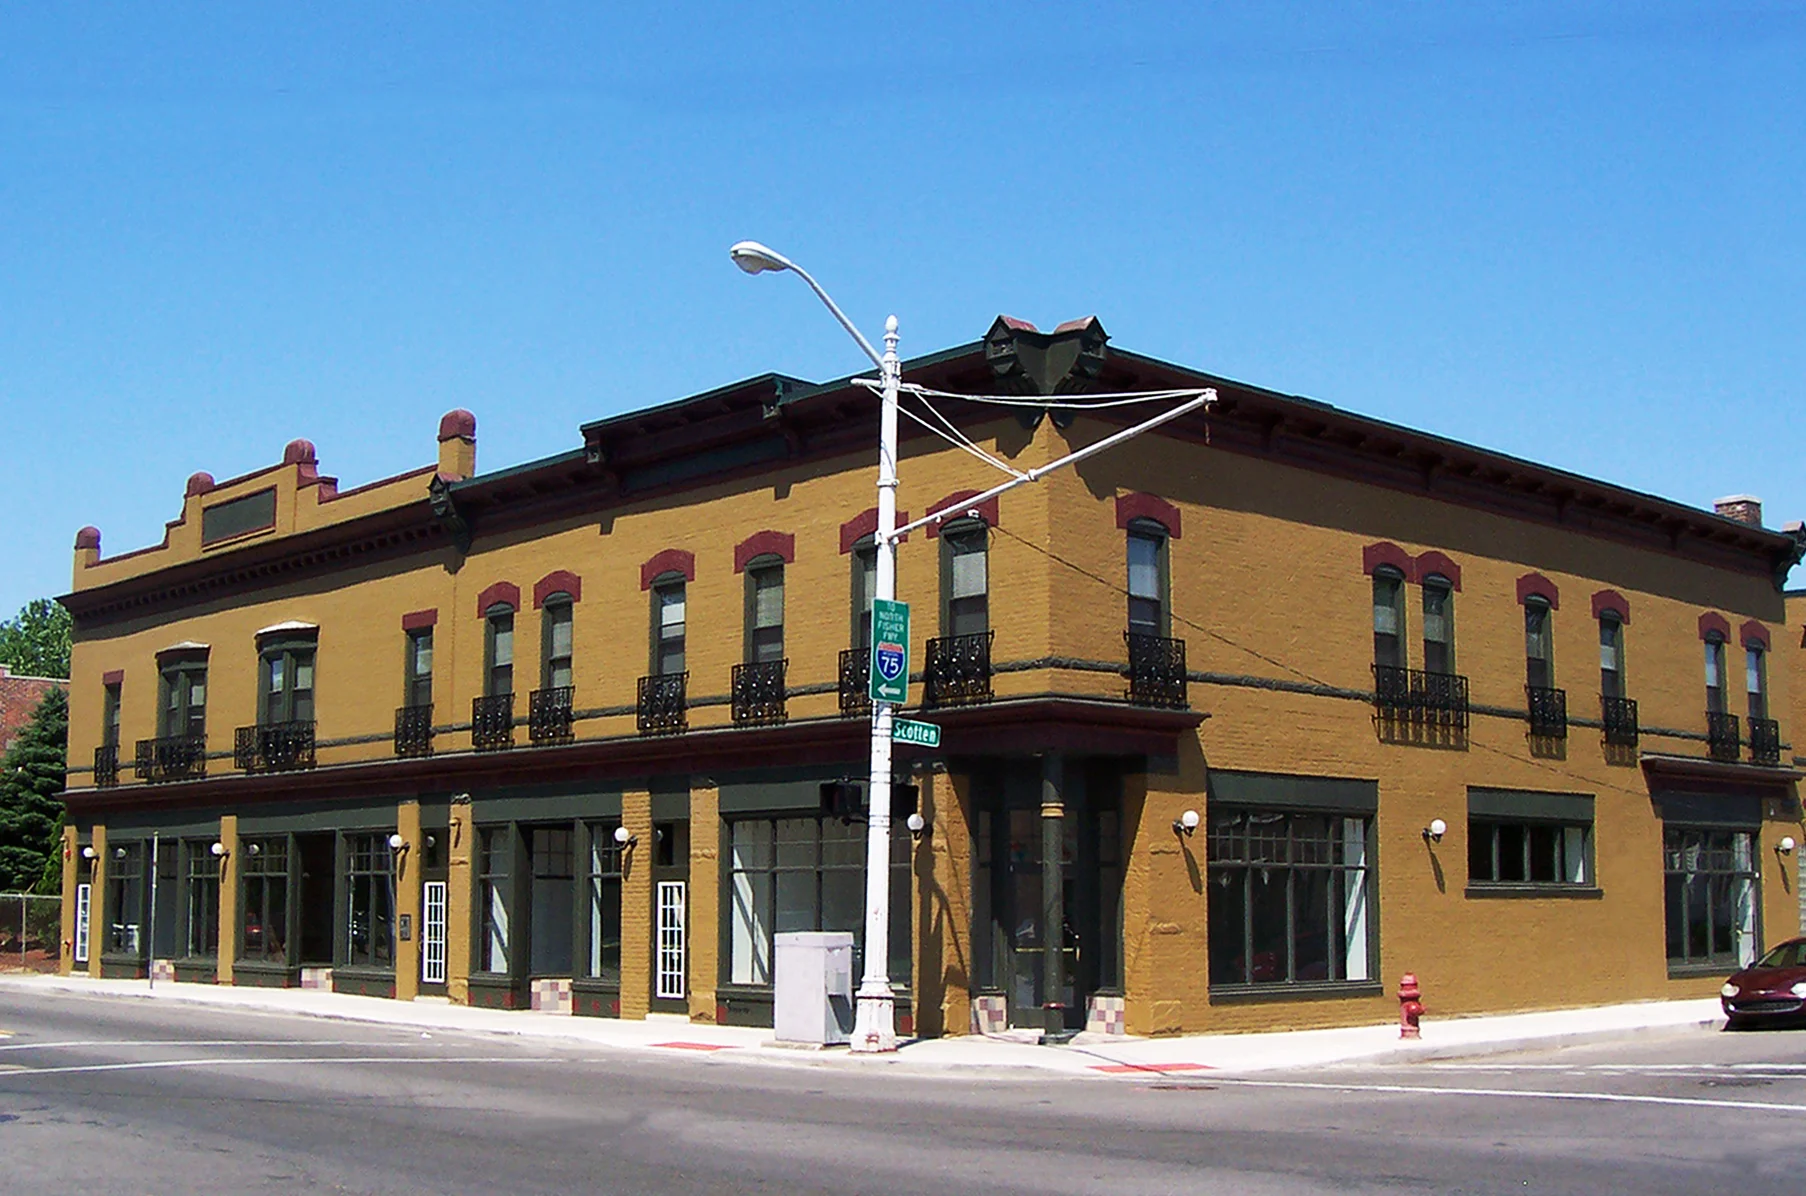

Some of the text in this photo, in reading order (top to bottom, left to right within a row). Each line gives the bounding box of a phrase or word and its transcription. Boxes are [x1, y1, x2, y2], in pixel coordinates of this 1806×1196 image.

[879, 611, 903, 622] NORTH
[878, 620, 904, 632] FISHER
[881, 656, 899, 674] 75
[894, 722, 936, 743] Scotten
